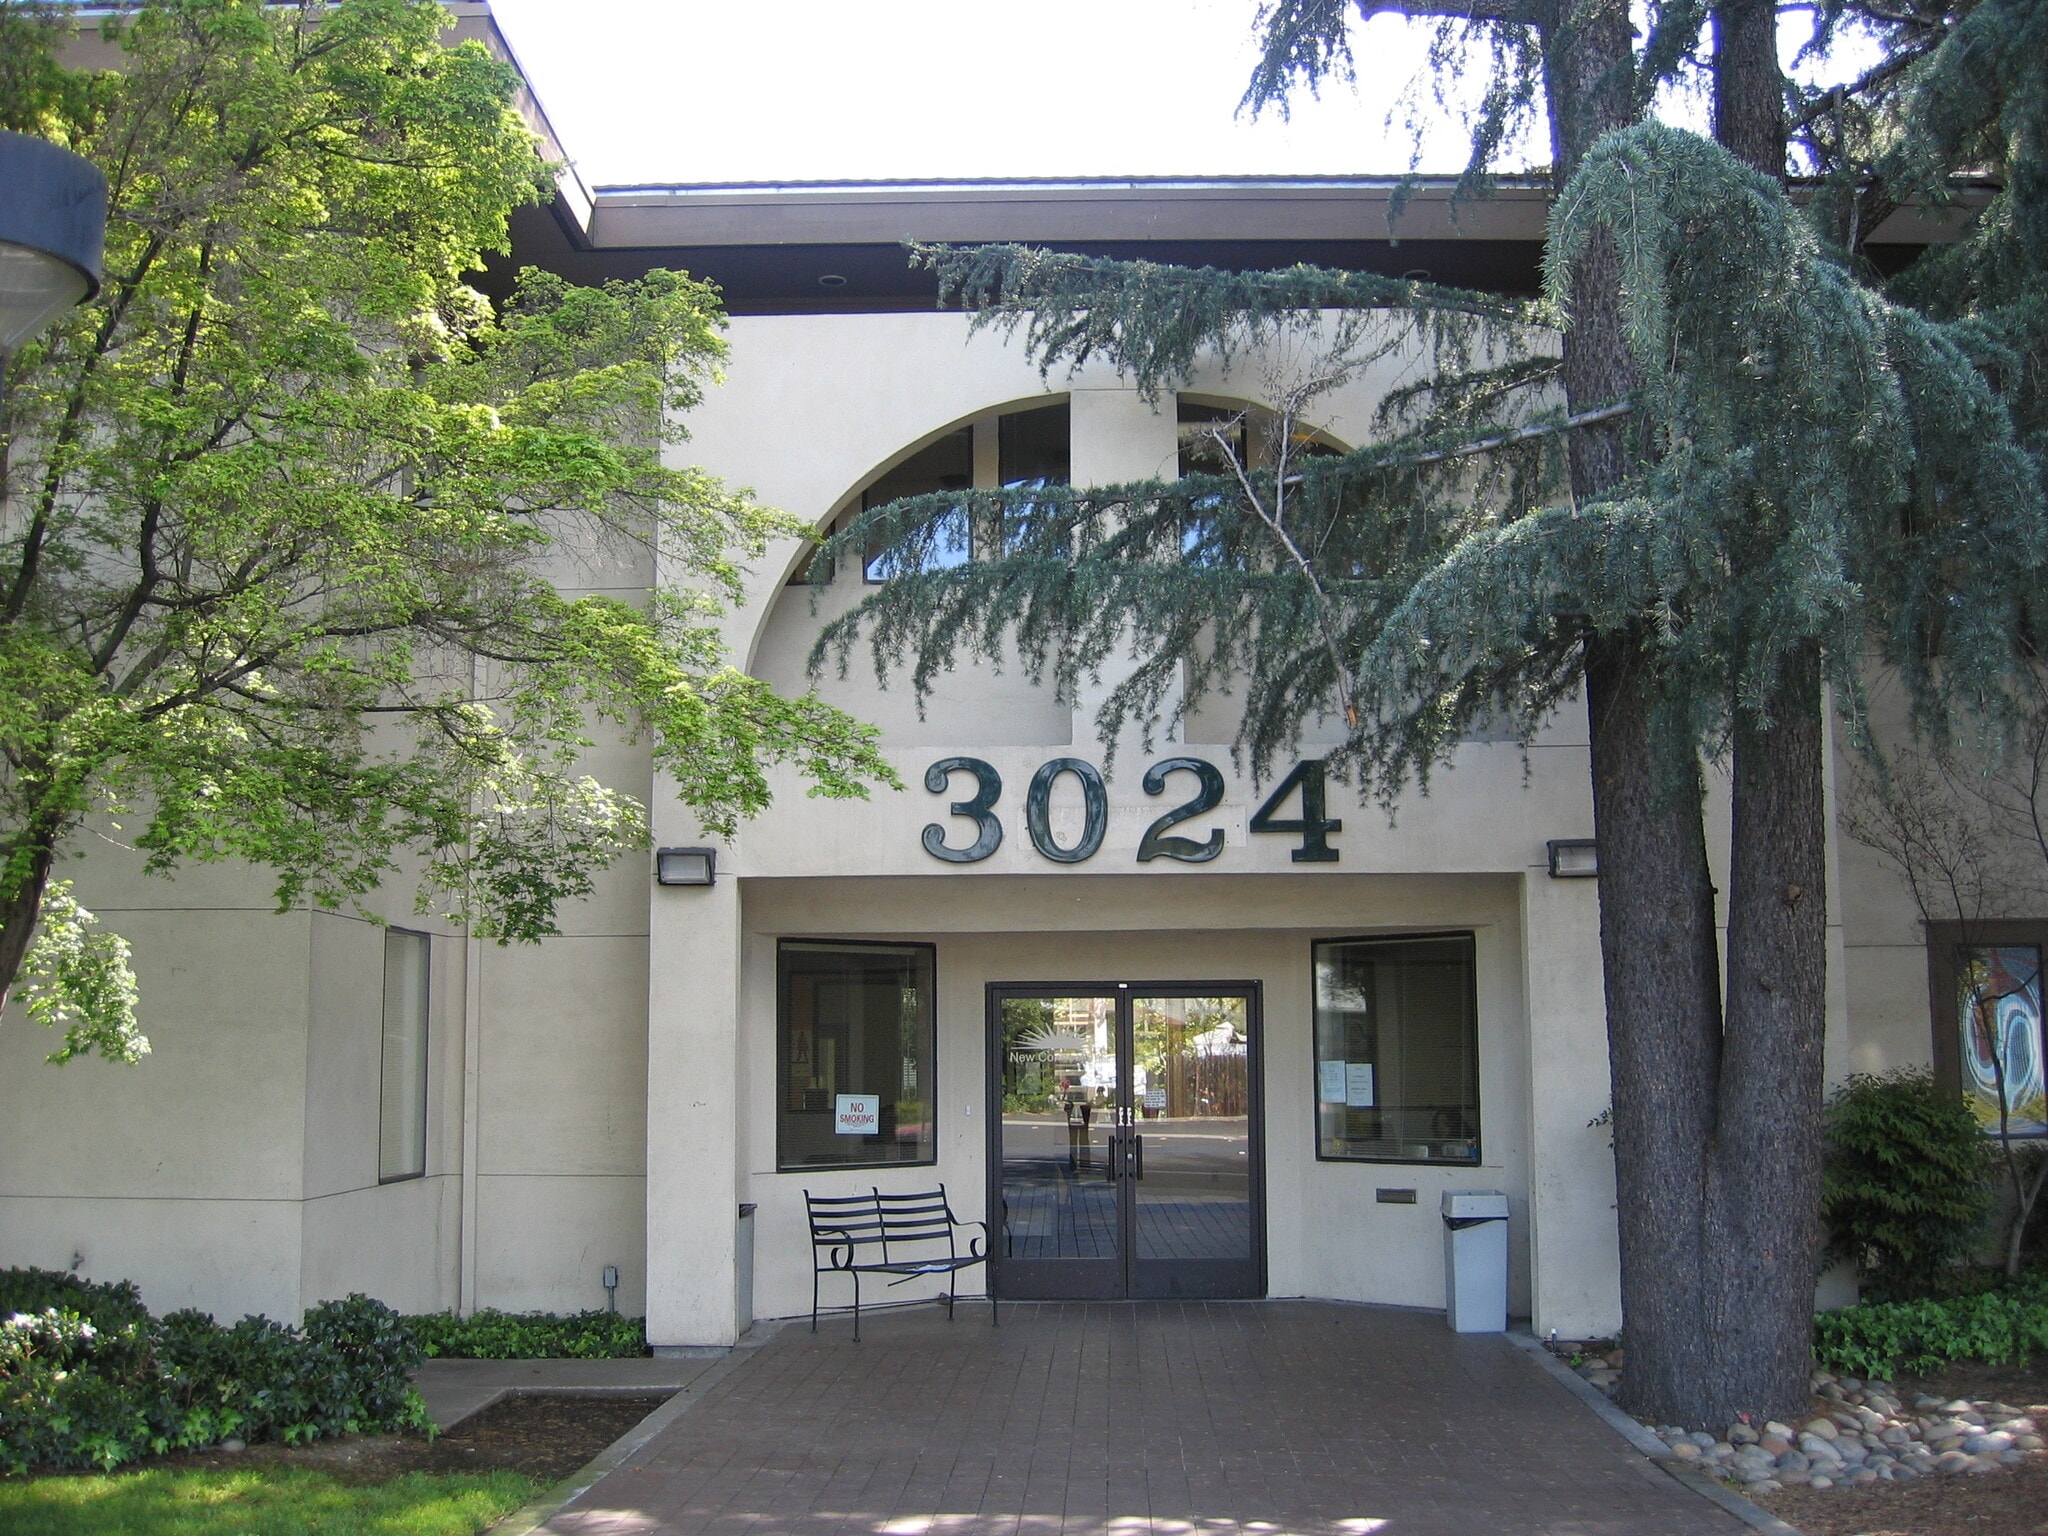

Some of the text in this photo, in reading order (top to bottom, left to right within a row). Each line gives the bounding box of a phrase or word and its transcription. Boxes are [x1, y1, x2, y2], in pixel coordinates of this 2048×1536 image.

[921, 756, 1342, 863] 3024
[1009, 1051, 1034, 1063] New
[850, 1102, 864, 1113] NO
[840, 1114, 874, 1123] SMOKING
